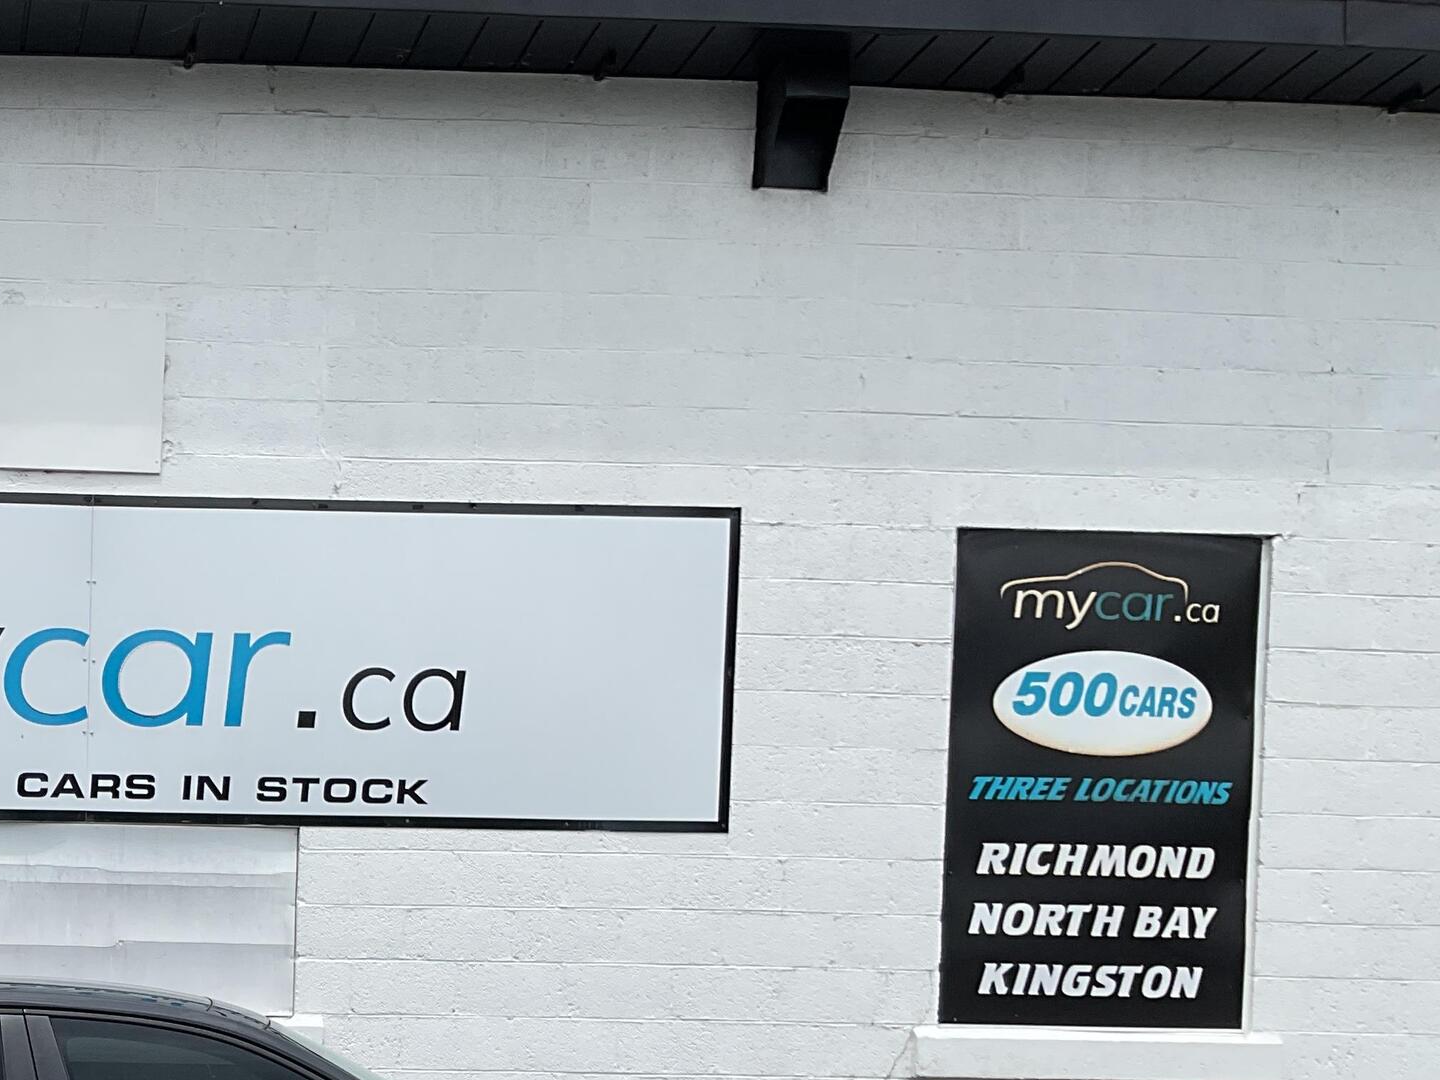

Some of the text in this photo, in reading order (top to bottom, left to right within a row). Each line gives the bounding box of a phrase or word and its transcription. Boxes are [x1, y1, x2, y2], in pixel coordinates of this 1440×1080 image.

[1013, 588, 1220, 630] mycar.ca
[16, 772, 156, 800] CARS
[182, 775, 231, 801] IN
[256, 776, 428, 805] STOCK
[968, 776, 1233, 805] THREE LOCATIONS
[975, 842, 1216, 880] RICHMOND
[967, 902, 1218, 939] NORTH BAY
[977, 962, 1204, 999] KINGSTON
